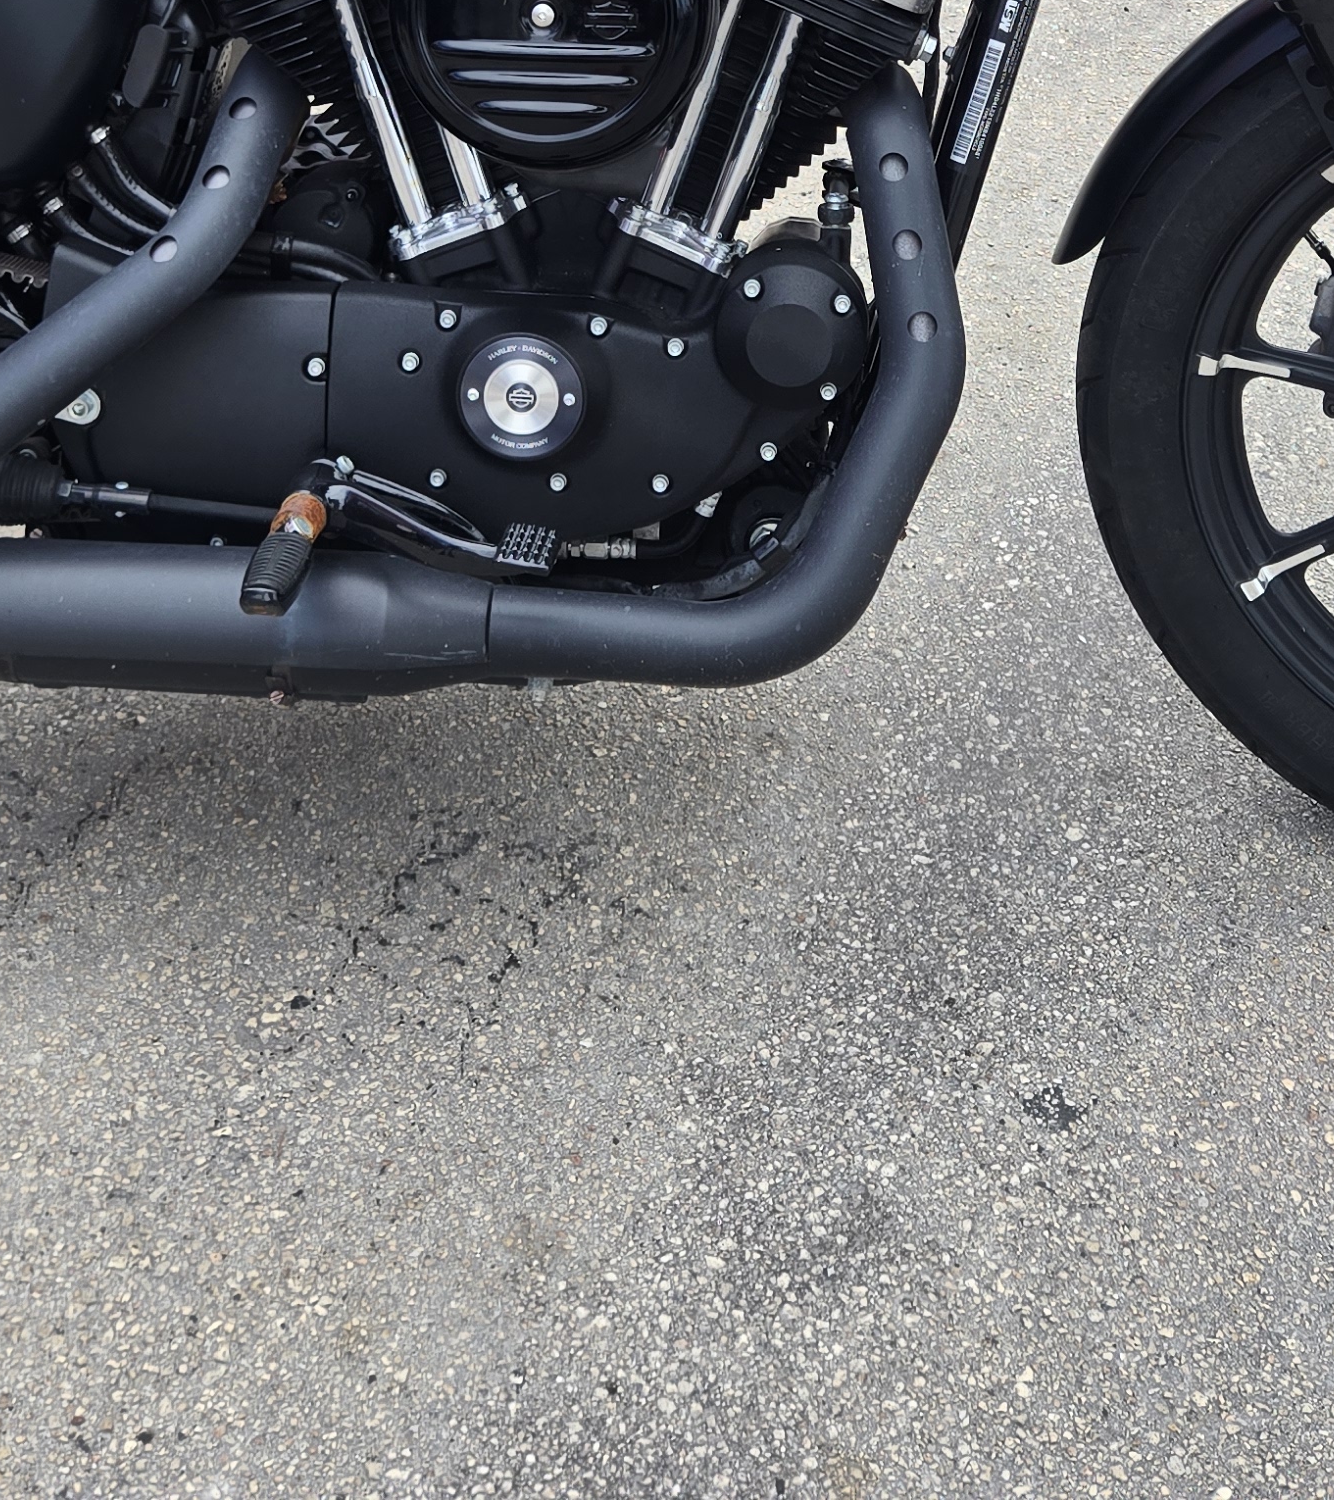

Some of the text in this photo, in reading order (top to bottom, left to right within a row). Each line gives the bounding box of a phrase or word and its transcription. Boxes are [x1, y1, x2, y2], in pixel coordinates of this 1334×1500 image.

[488, 345, 559, 364] HARLEY DAVIDSON
[491, 433, 549, 449] MOTOR COMPANY
